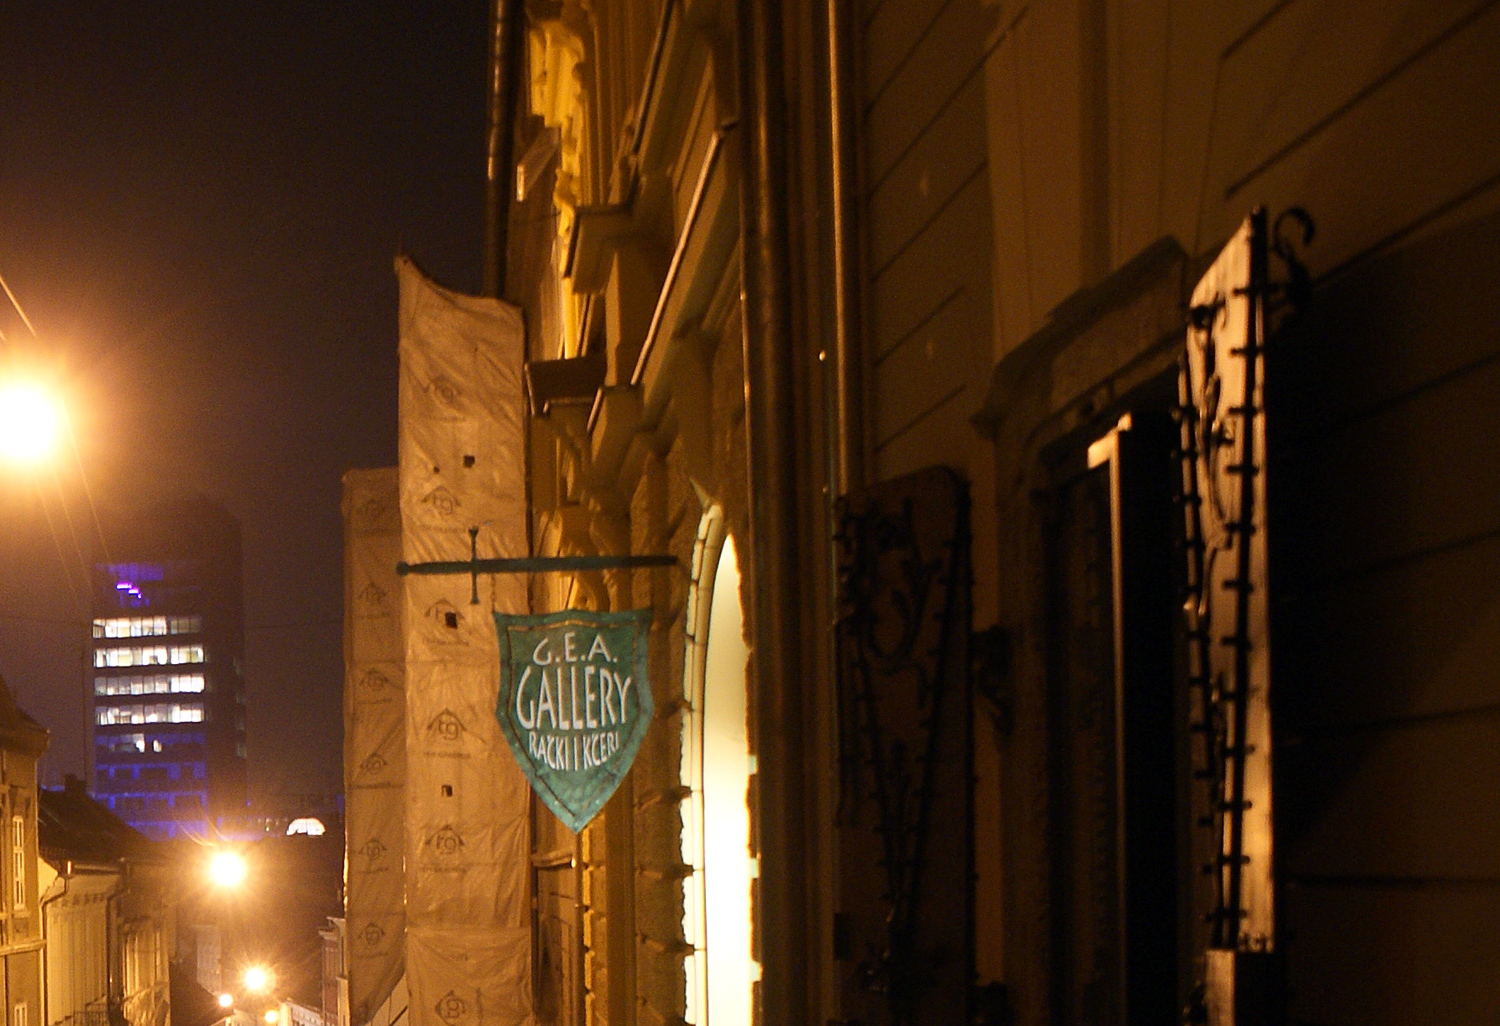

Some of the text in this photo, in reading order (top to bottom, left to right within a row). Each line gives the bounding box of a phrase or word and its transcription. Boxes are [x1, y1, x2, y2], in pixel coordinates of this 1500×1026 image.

[533, 632, 618, 666] G.E.A.
[516, 666, 632, 731] GALLERY
[529, 731, 568, 771] RAČKI
[583, 731, 620, 770] KČERI
